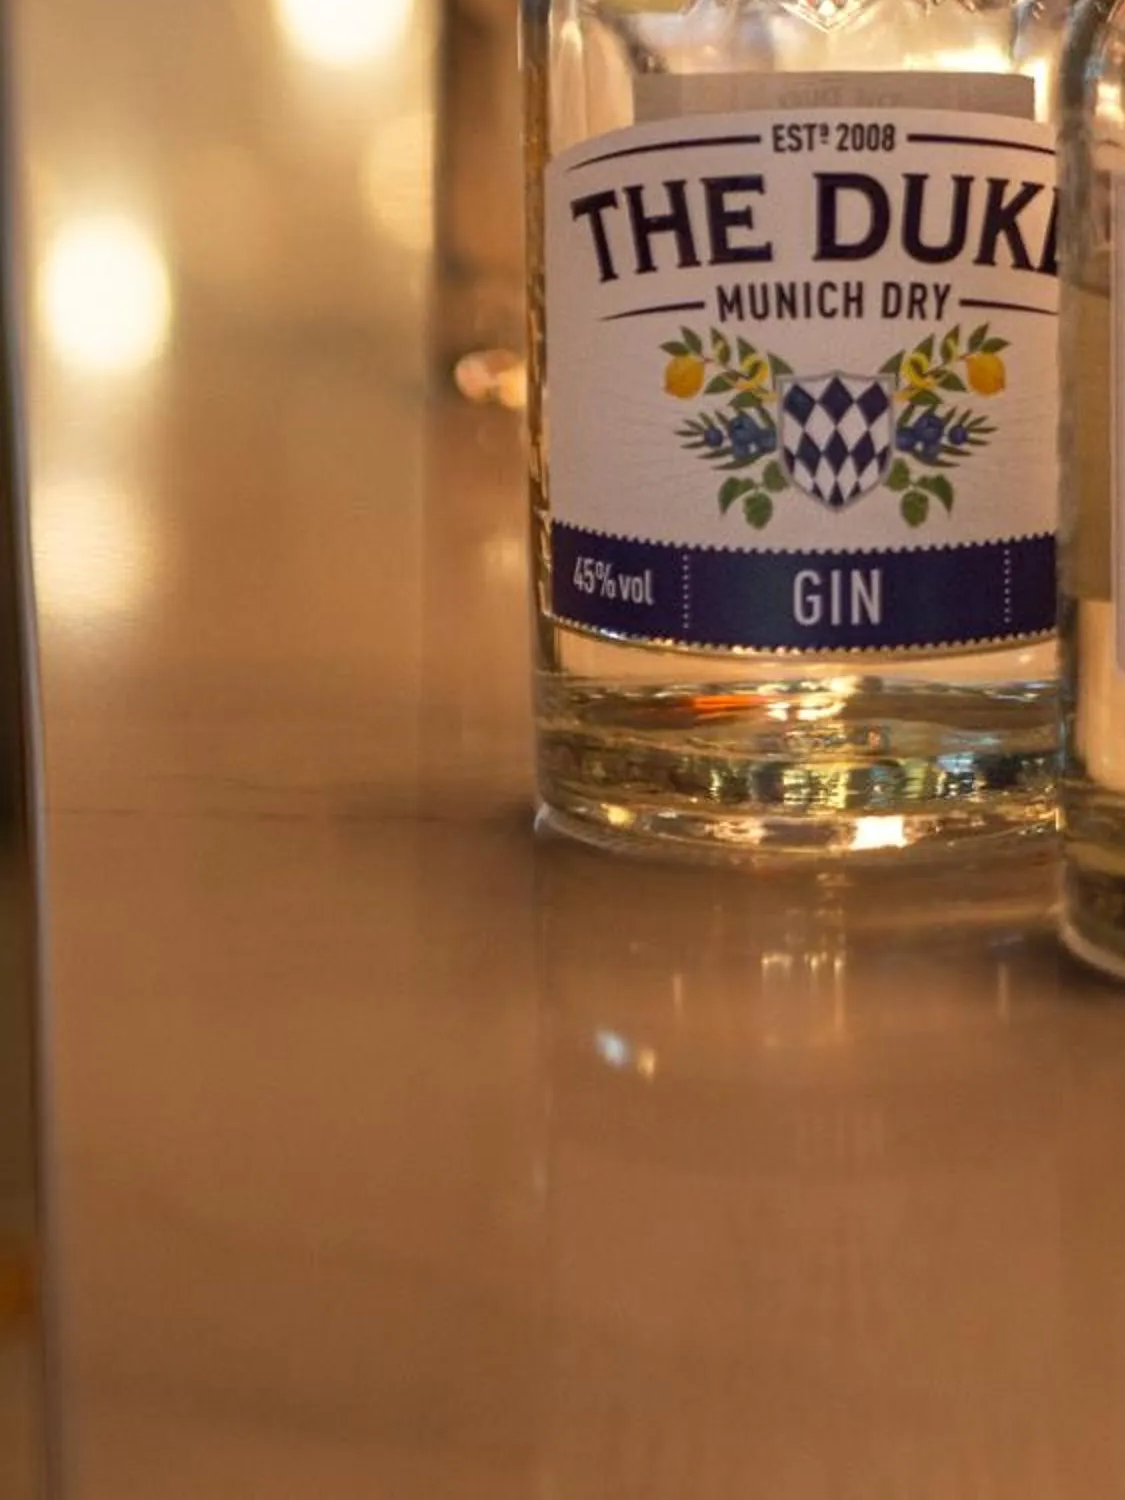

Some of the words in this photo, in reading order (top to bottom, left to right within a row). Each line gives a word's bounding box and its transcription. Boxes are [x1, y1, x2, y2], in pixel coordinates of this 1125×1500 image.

[835, 123, 896, 152] 2008
[570, 174, 773, 284] THE
[716, 282, 865, 322] MUNICH
[881, 283, 952, 321] DRY
[573, 556, 616, 599] 45%
[617, 569, 654, 605] vol
[792, 569, 881, 626] GIN
